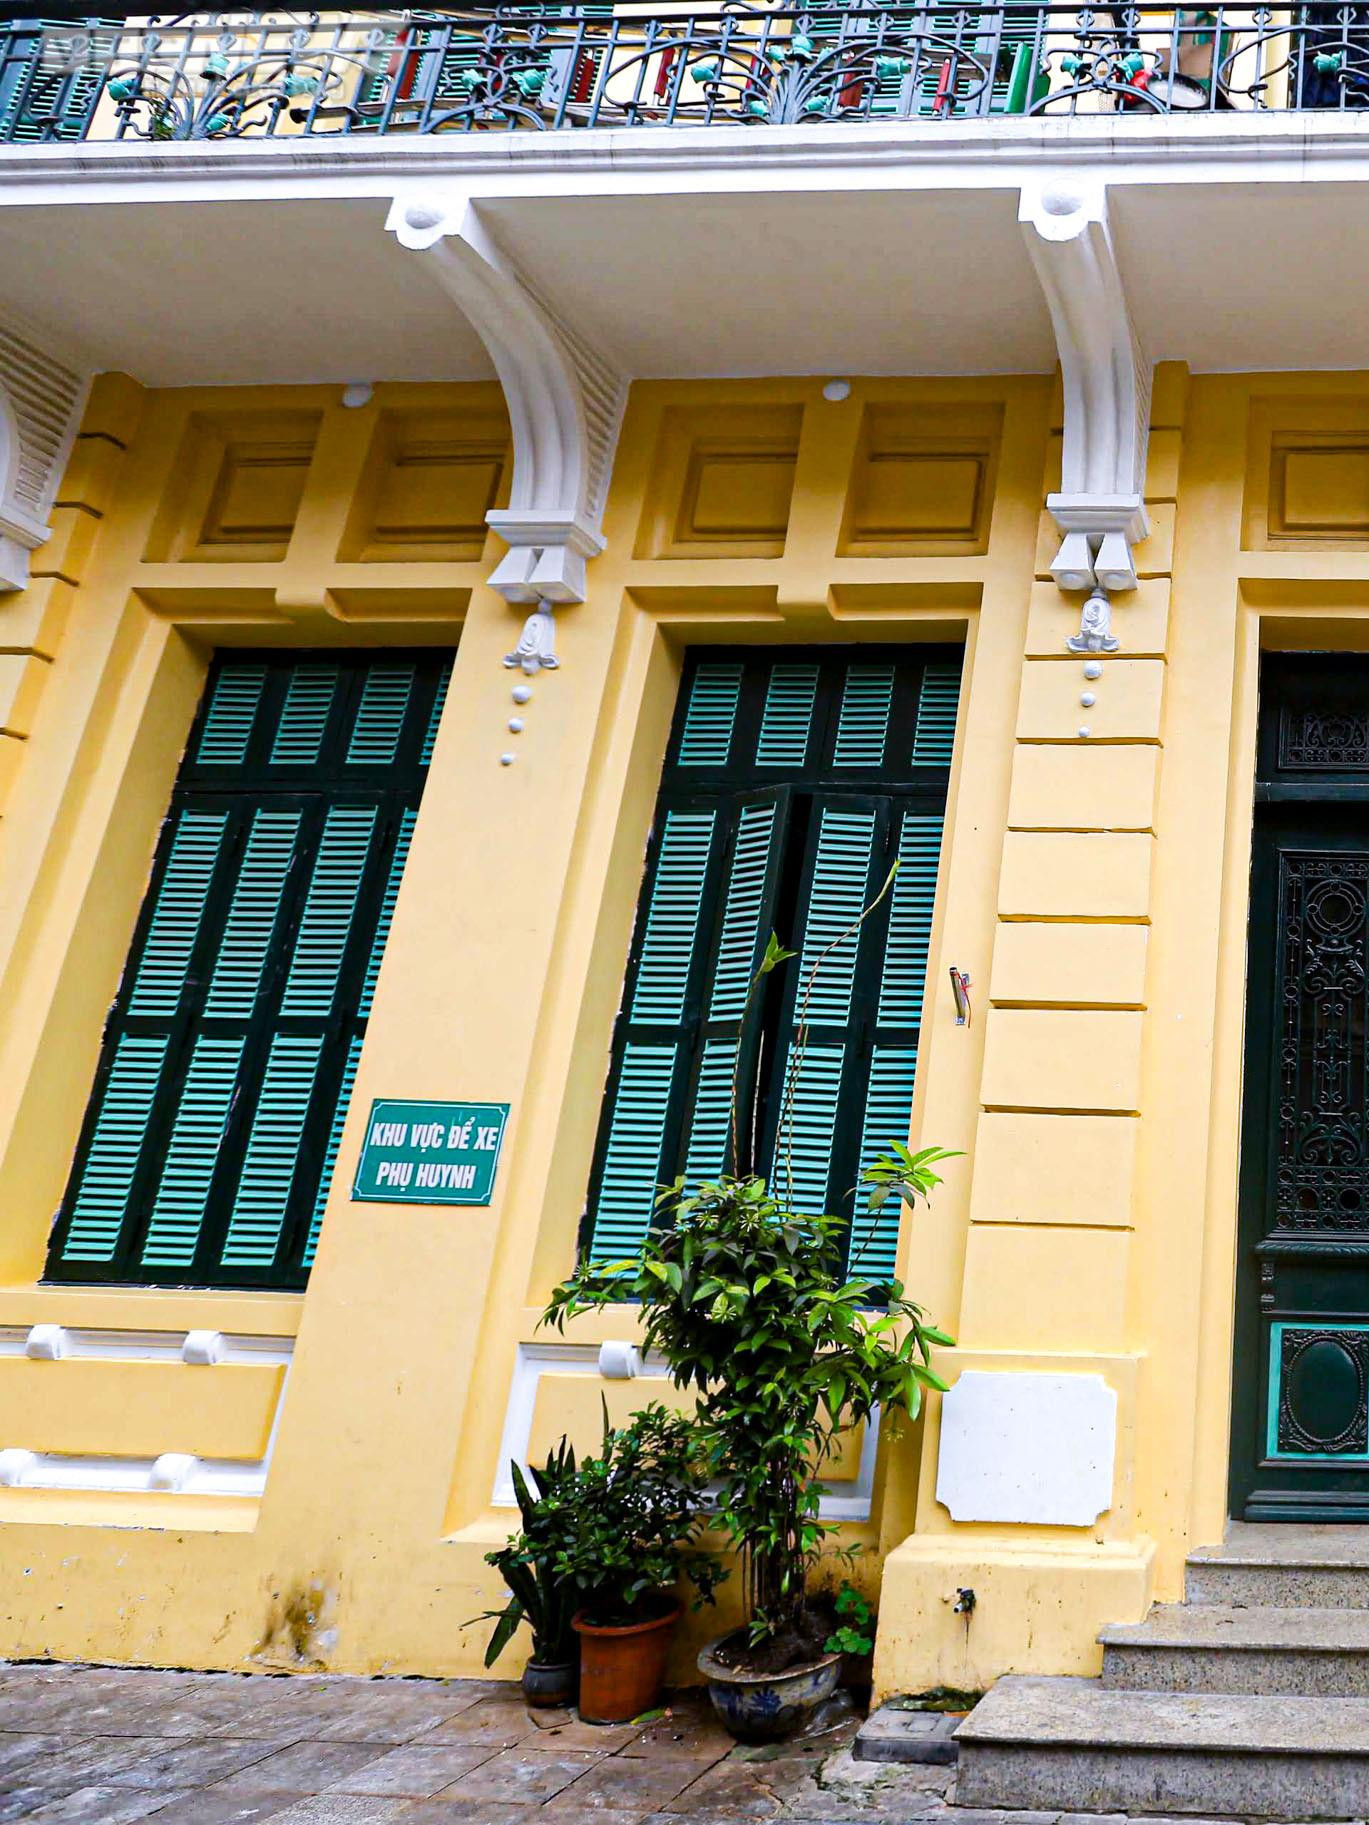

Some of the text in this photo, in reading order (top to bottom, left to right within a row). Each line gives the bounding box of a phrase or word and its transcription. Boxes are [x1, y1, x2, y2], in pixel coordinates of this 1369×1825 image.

[370, 1117, 499, 1153] KHU VỰC ĐỂ XE
[375, 1162, 476, 1191] PHỤ HUYNH
